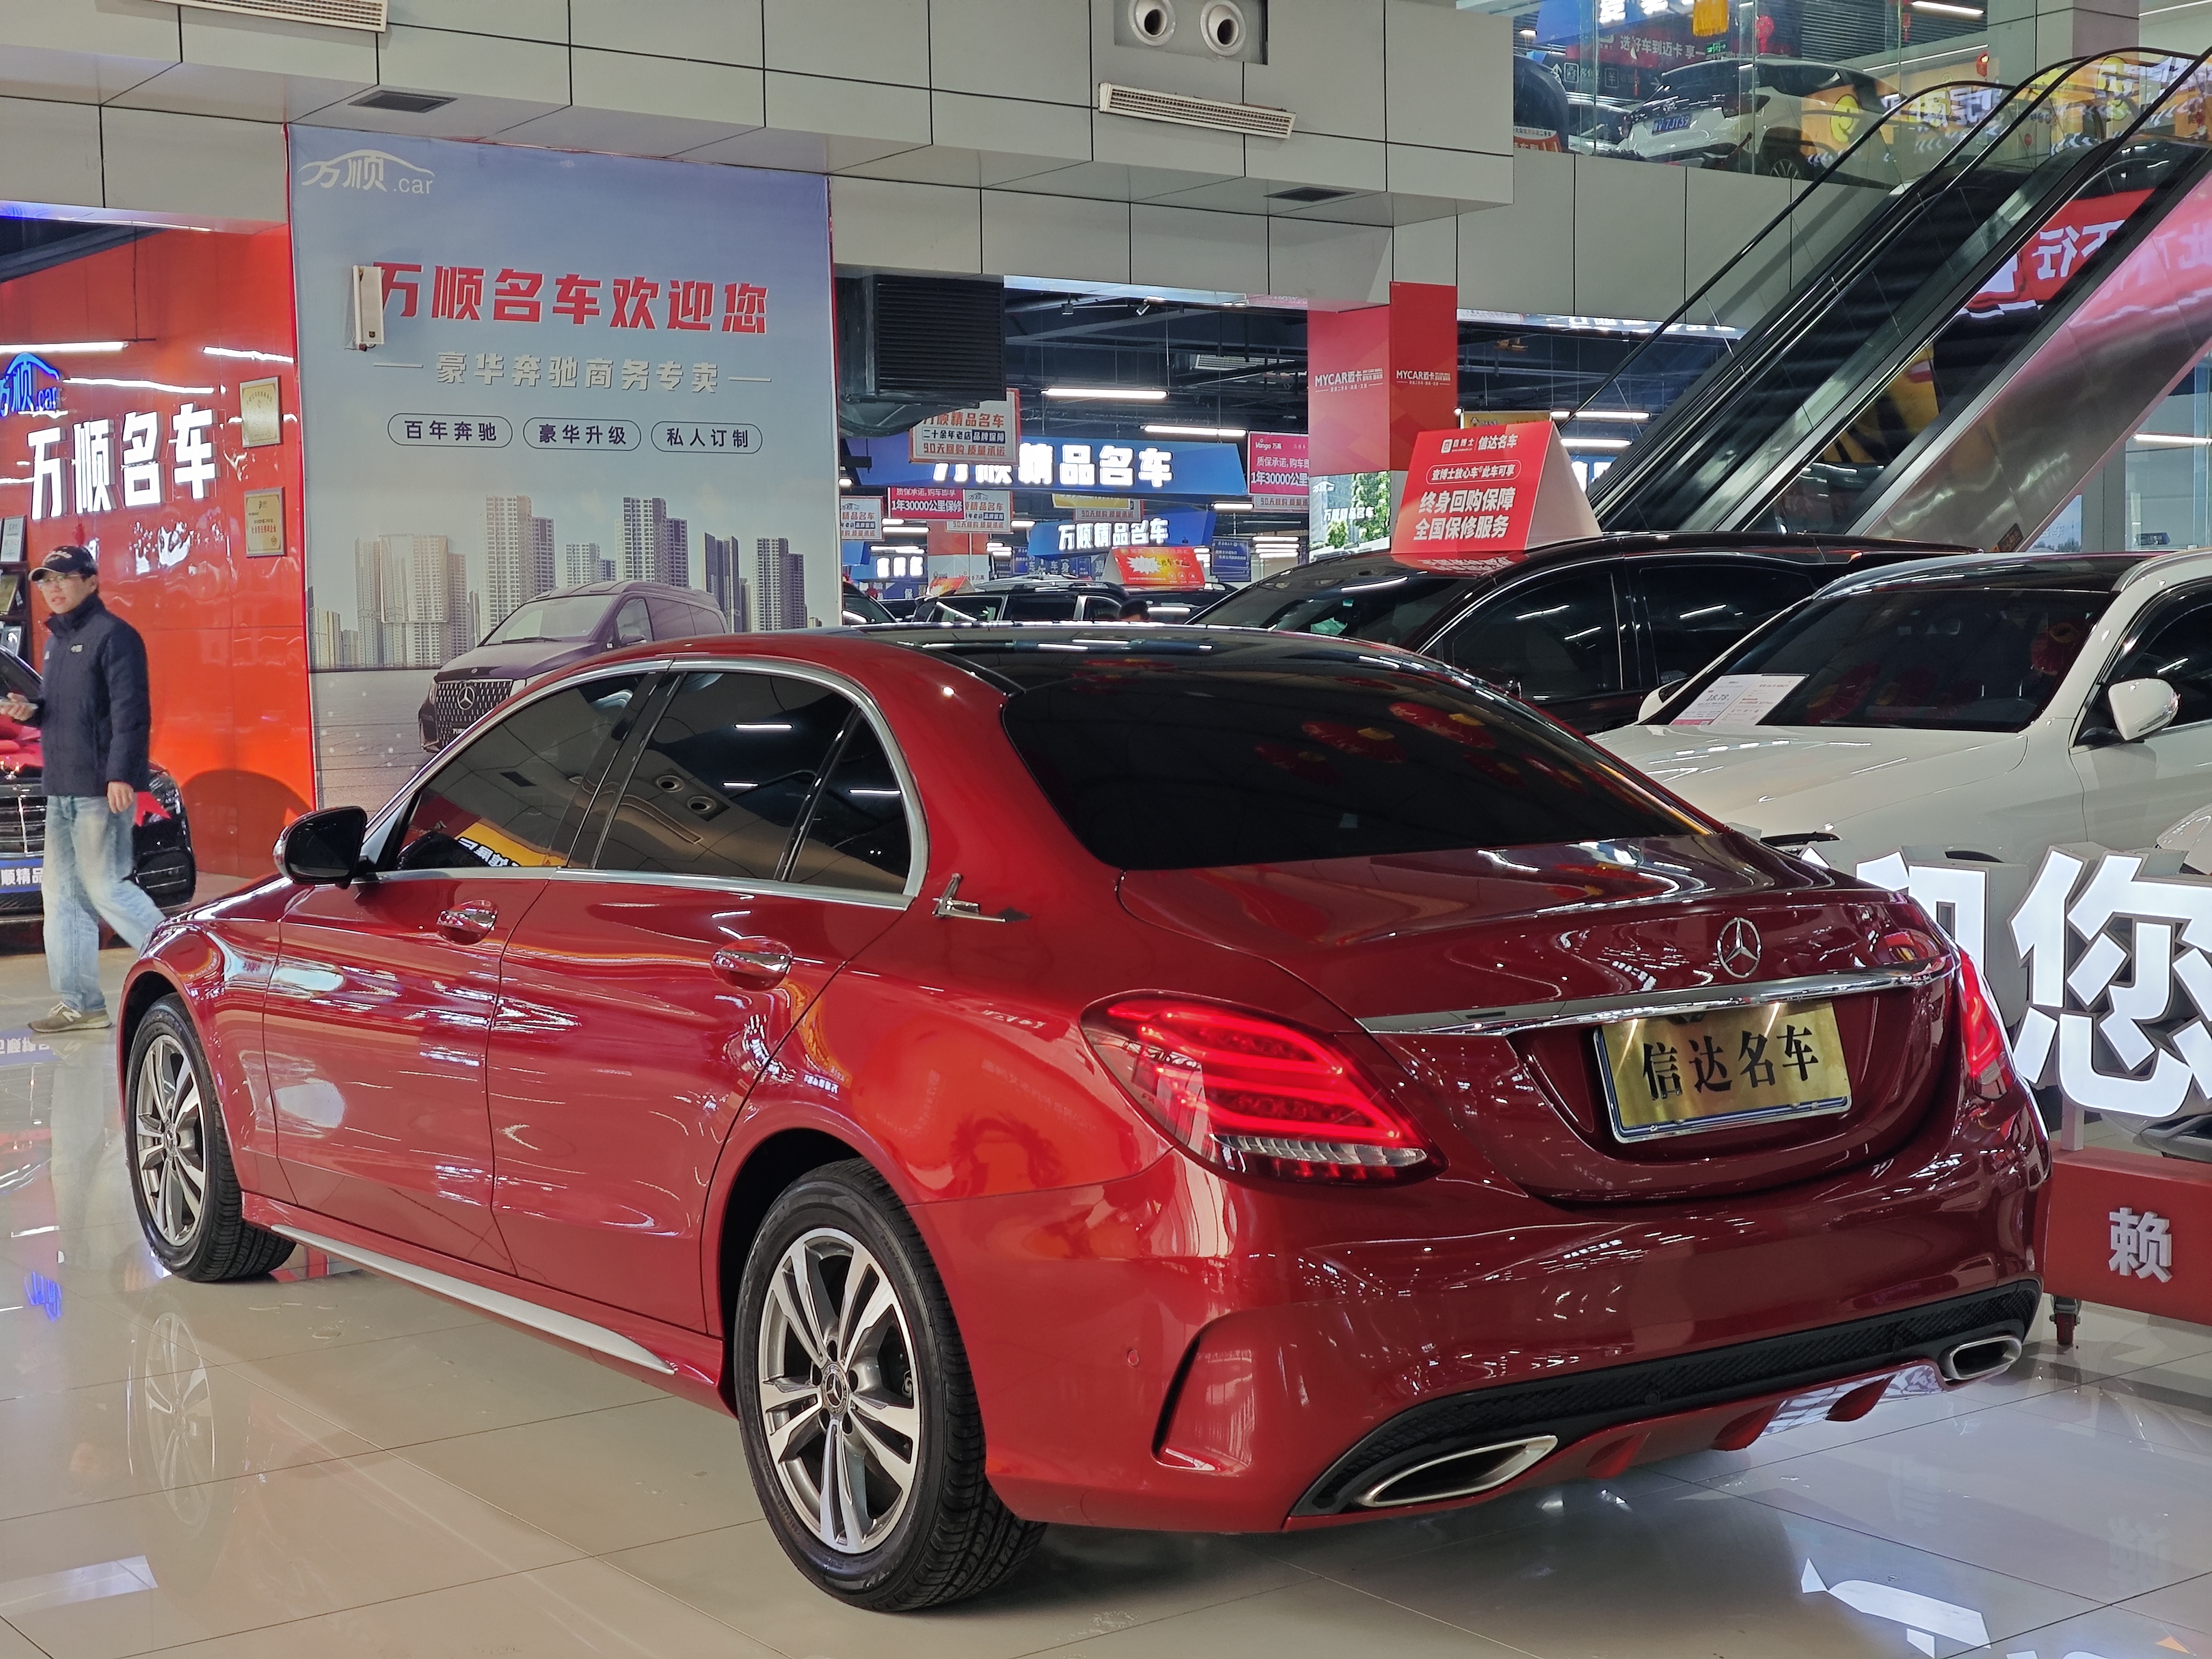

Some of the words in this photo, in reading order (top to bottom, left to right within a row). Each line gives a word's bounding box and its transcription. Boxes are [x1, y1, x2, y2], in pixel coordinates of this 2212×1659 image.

[373, 262, 769, 334] 万顺名车欢迎您
[435, 351, 720, 394] 豪华奔驰商务专卖
[404, 419, 498, 442] 百年奔驰
[538, 423, 628, 446] 豪华升级
[666, 428, 748, 448] 私人订制
[923, 429, 971, 441] 二十余年老店
[1478, 434, 1518, 450] 信达名车
[923, 442, 964, 454] 90天回购
[968, 444, 1005, 456] 质量承诺
[27, 402, 220, 521] 万顺名车
[1251, 471, 1309, 487] 1年30000公里
[892, 499, 962, 512] 1年30000公里保修
[1418, 486, 1516, 514] 终身回购保障
[1413, 515, 1510, 541] 全国保修服务
[1643, 1024, 1819, 1101] 信达名车
[2108, 1206, 2173, 1283] 赖
